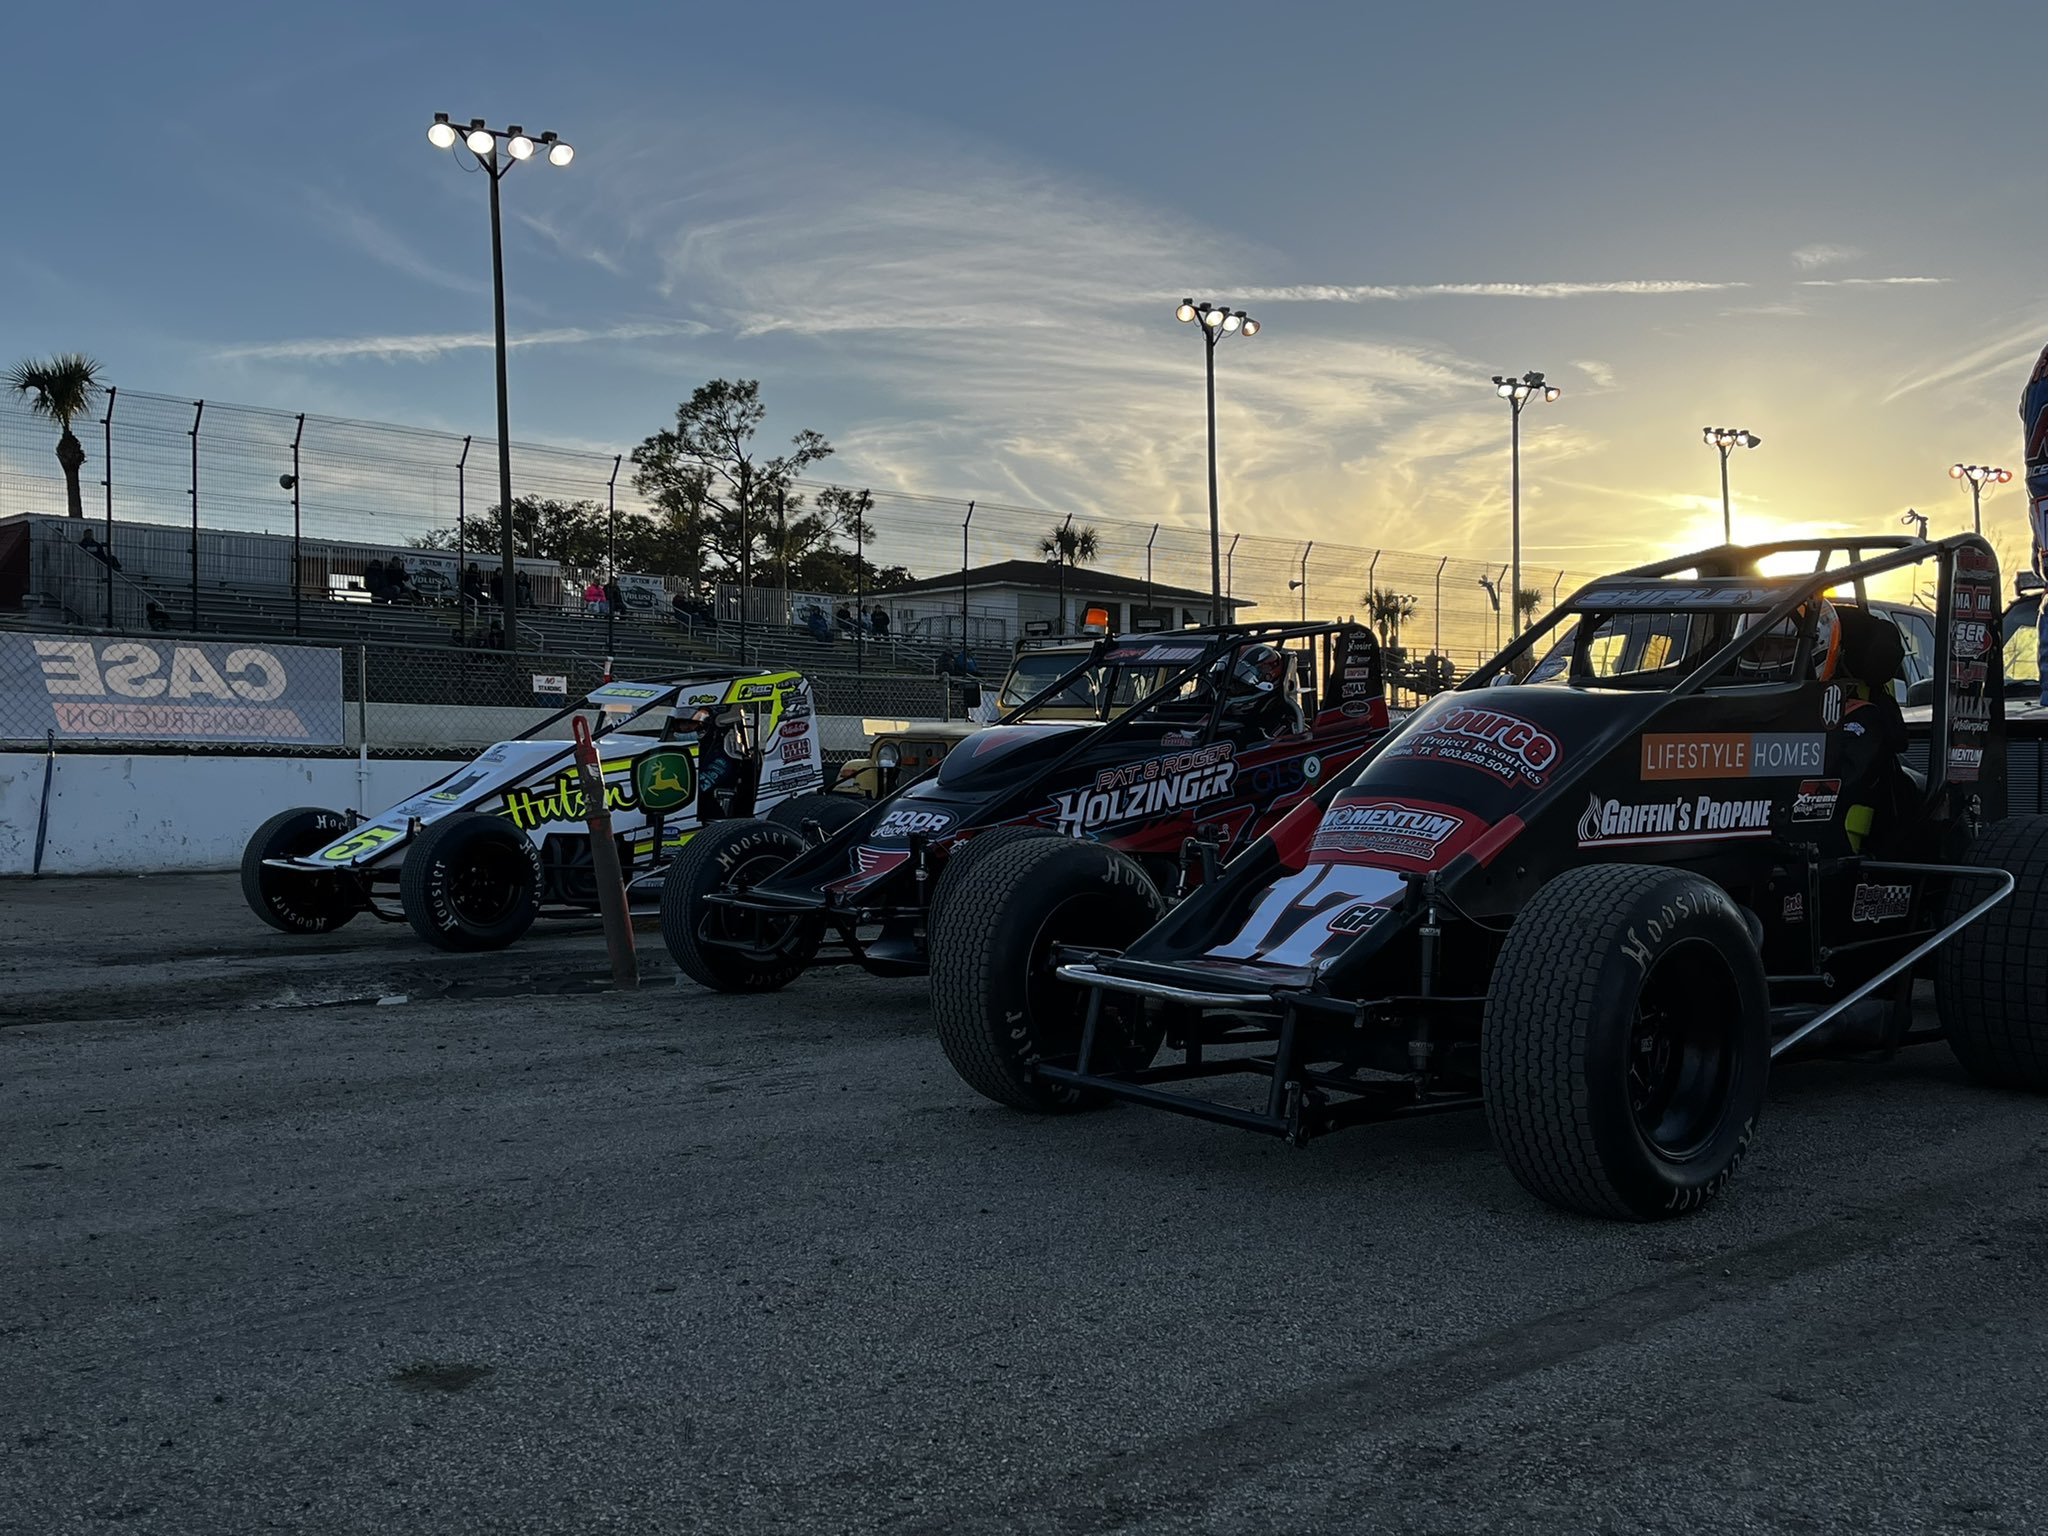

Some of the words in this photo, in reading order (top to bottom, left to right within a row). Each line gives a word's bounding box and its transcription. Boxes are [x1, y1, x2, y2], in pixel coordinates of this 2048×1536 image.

[545, 677, 556, 685] NO
[1097, 765, 1141, 792] PAT
[1143, 761, 1159, 779] &
[1161, 744, 1232, 775] ROGER
[1418, 746, 1433, 755] TX
[1422, 736, 1469, 748] Project
[1474, 742, 1543, 785] Resources
[1647, 742, 1745, 770] LIFESTYLE
[1754, 742, 1820, 768] HOMES
[1252, 759, 1303, 793] QLS
[497, 778, 638, 829] Hutsn
[881, 811, 950, 831] POOR
[1055, 762, 1235, 839] HOLZINGER
[1601, 796, 1691, 836] GRIFFIN'S
[1693, 795, 1773, 831] PROPANE
[323, 826, 401, 861] 5
[1353, 825, 1434, 838] SUSPENSIONS
[715, 832, 789, 873] Hoosier
[519, 840, 544, 907] Hoosier
[272, 895, 328, 931] Hoosier
[431, 860, 460, 932] Hoosier
[1619, 891, 1725, 972] Hoosier
